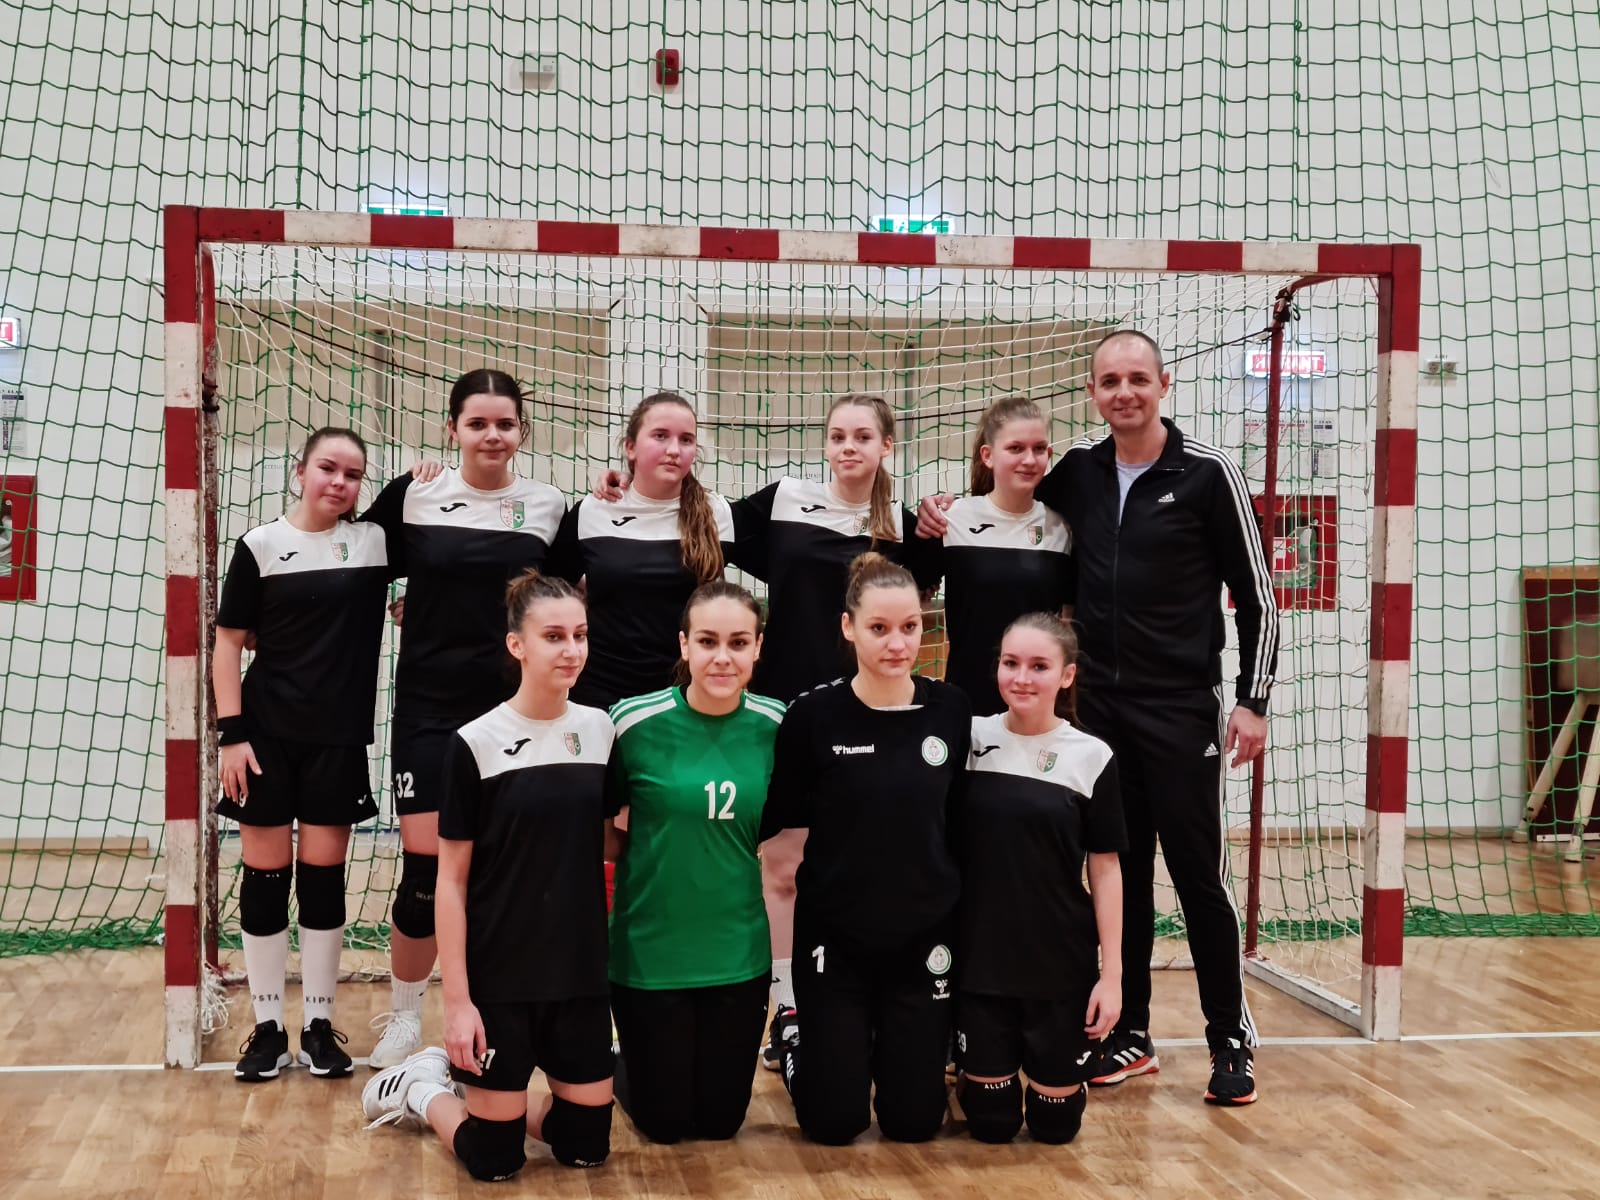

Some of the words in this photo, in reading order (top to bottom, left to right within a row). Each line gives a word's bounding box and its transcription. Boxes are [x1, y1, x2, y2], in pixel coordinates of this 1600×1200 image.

[843, 744, 875, 755] hummel
[396, 772, 415, 799] 32
[704, 780, 737, 820] 12
[812, 945, 825, 973] 1
[985, 1080, 1011, 1090] ALLSIX
[1038, 1094, 1066, 1104] ALLSIX
